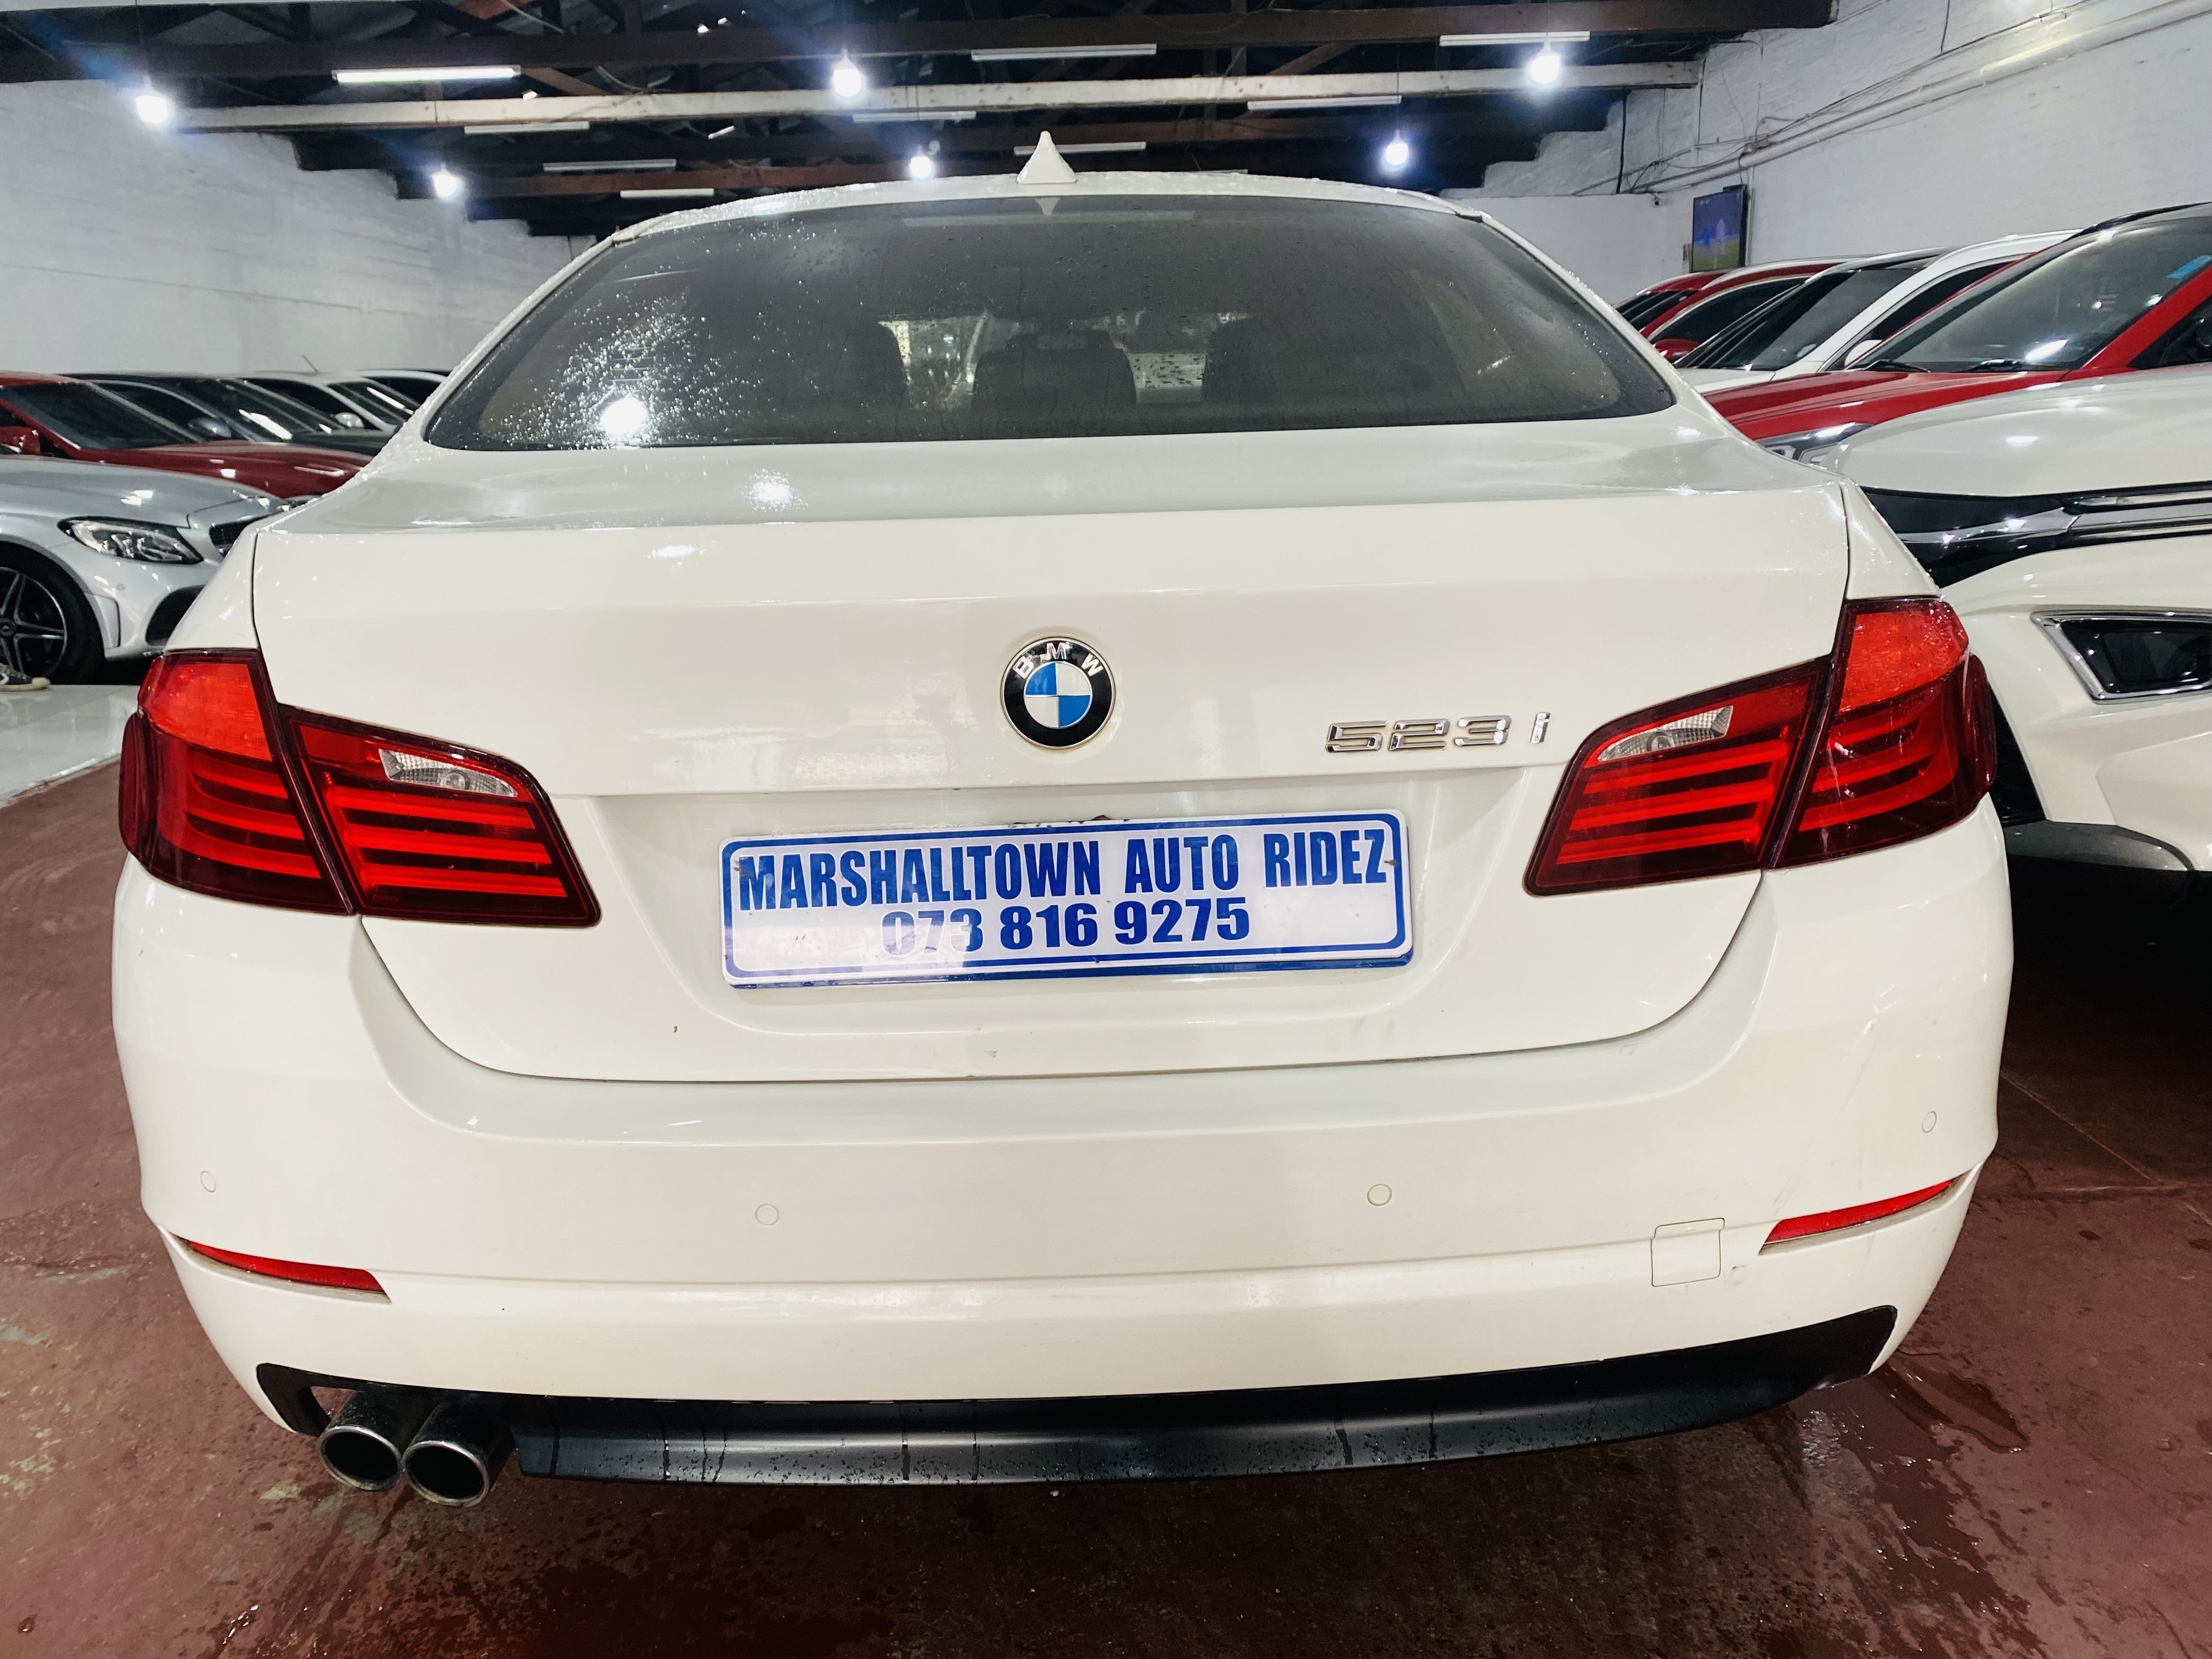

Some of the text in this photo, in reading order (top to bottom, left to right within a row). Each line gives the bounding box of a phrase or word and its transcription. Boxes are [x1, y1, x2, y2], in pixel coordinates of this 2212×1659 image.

[1012, 642, 1104, 679] BMW
[738, 829, 1387, 911] MARSHALLTOWN AUTO RIDEZ
[882, 896, 1250, 956] 073 816 9275
